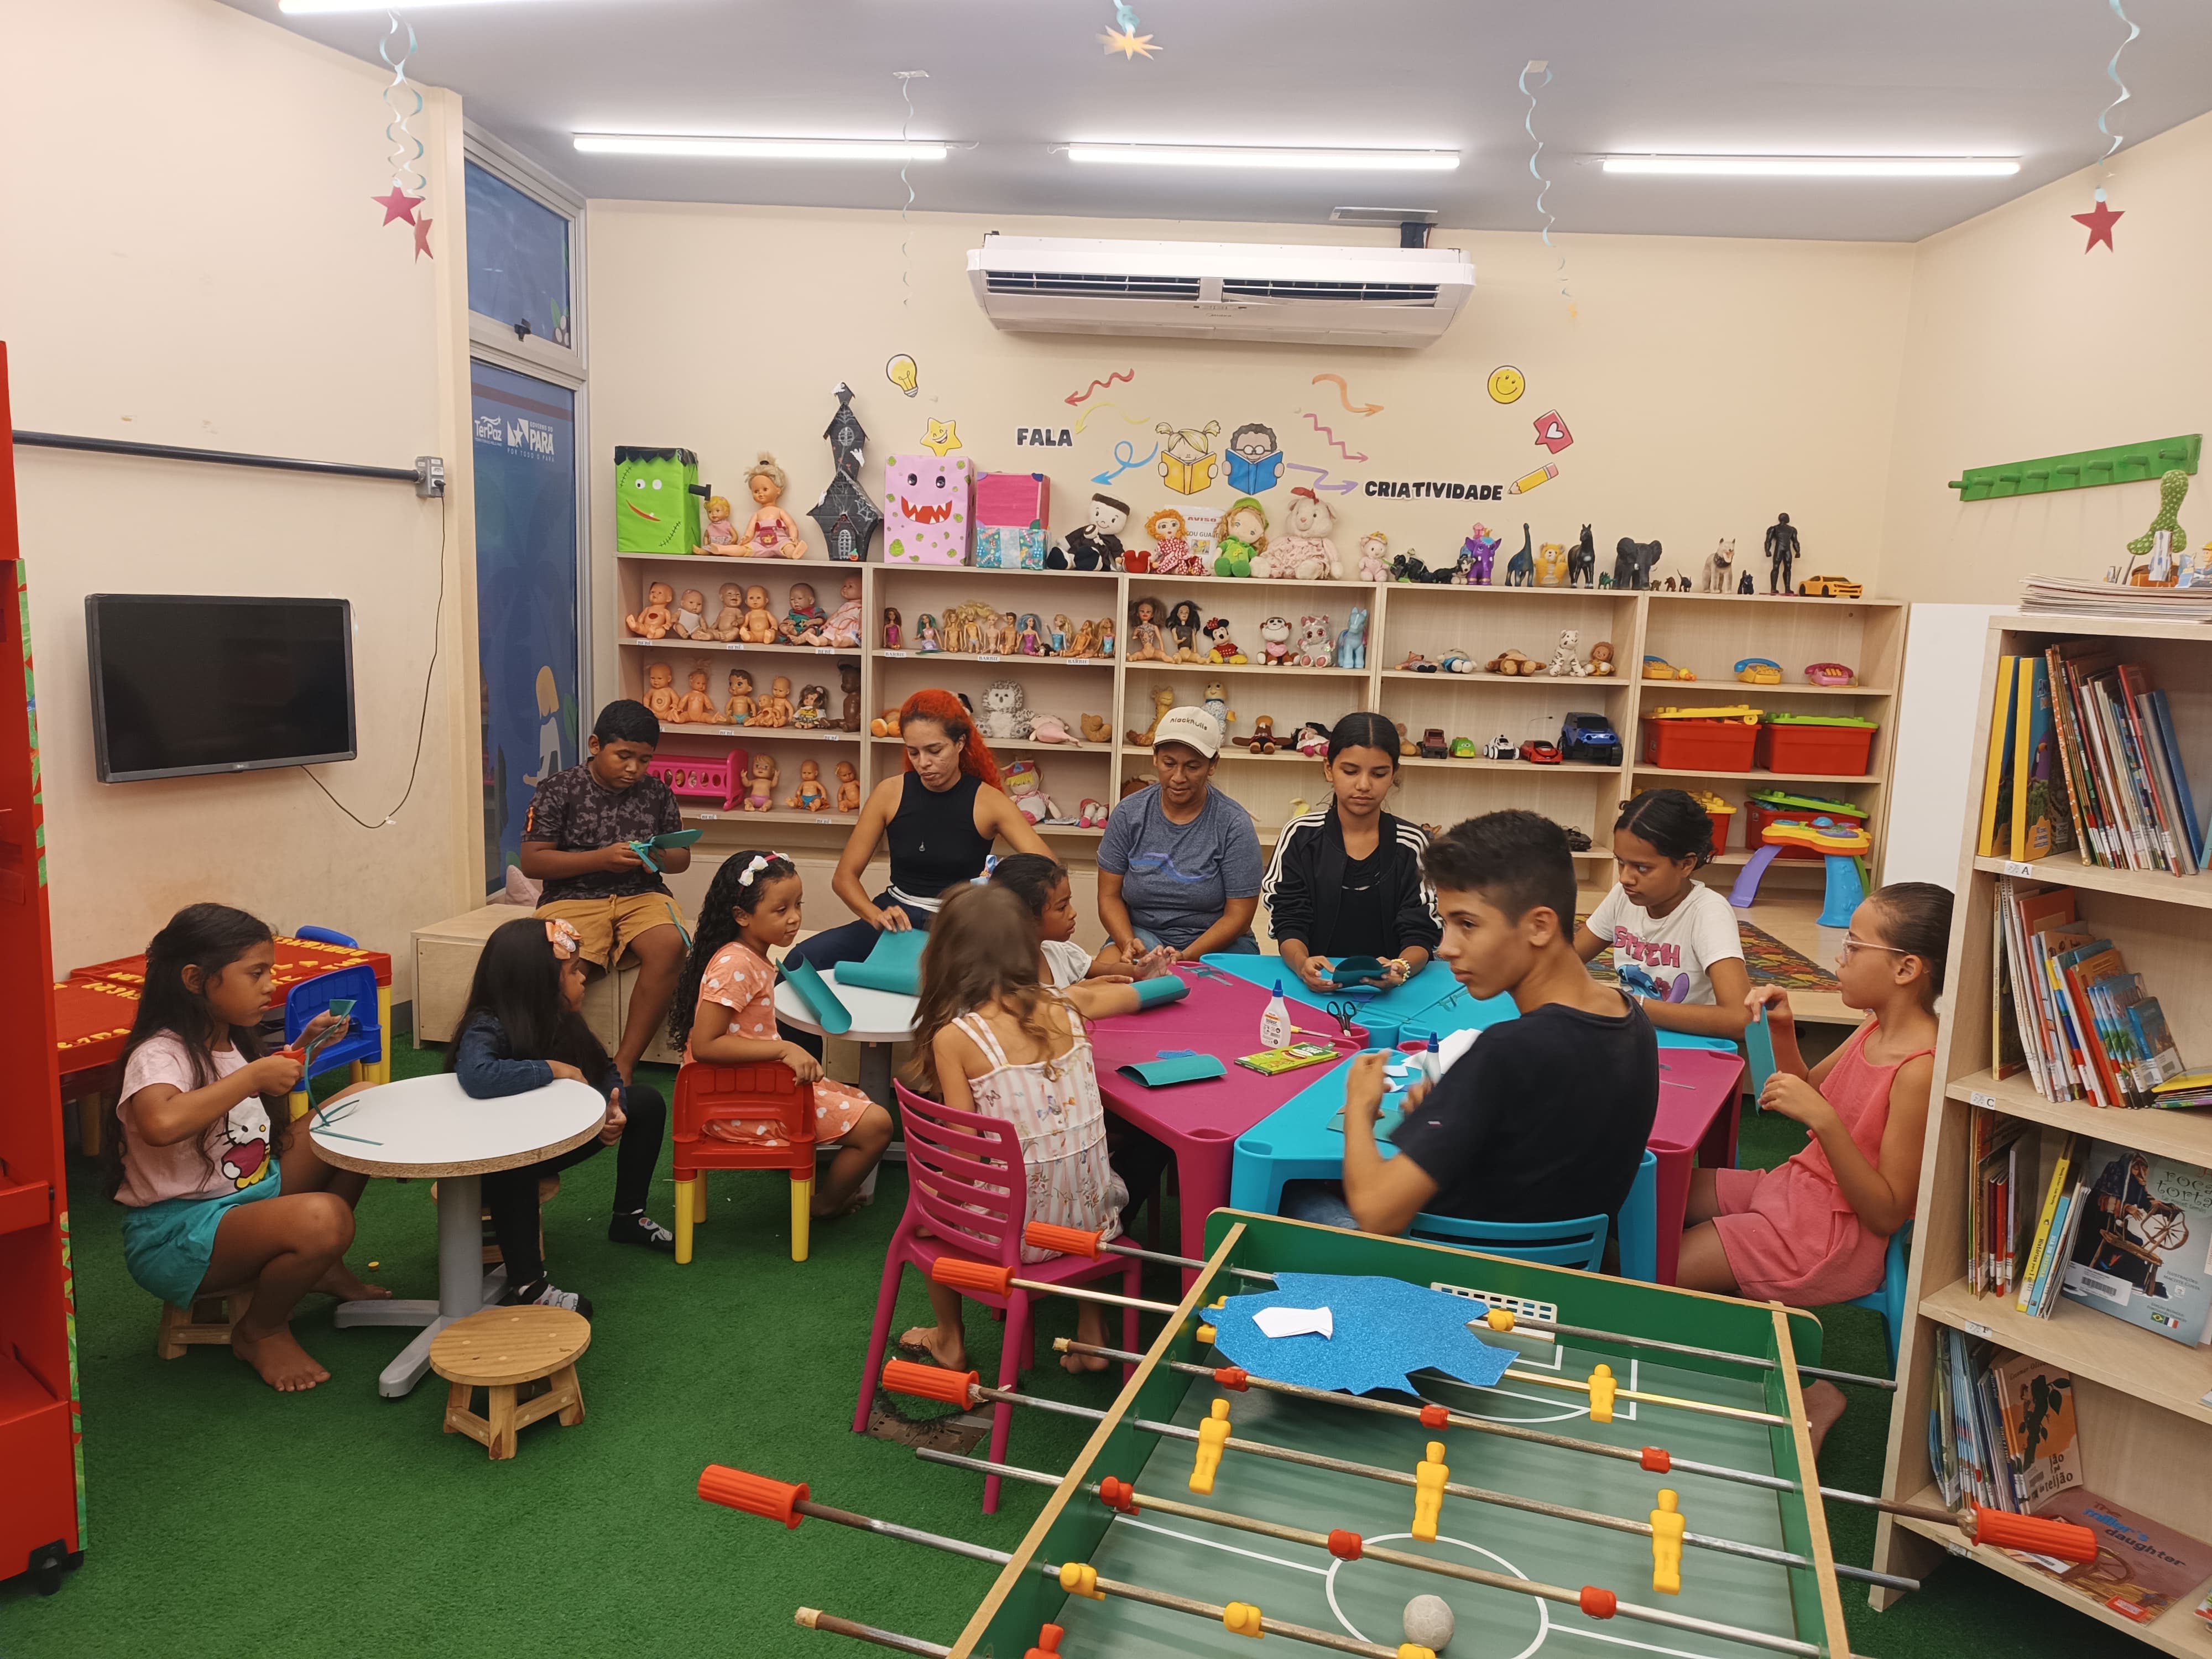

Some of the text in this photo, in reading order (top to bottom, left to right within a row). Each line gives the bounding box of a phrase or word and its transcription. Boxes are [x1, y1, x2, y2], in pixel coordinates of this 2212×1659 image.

[474, 420, 502, 442] TerPaz
[1017, 428, 1073, 447] FALA
[1364, 481, 1503, 500] CRIATIVIDADE
[2021, 867, 2030, 875] A
[1614, 925, 1680, 968] STICH
[1987, 1099, 1994, 1107] C
[2164, 1171, 2212, 1194] roca
[2156, 1180, 2212, 1208] torta
[2105, 1528, 2186, 1566] daughter
